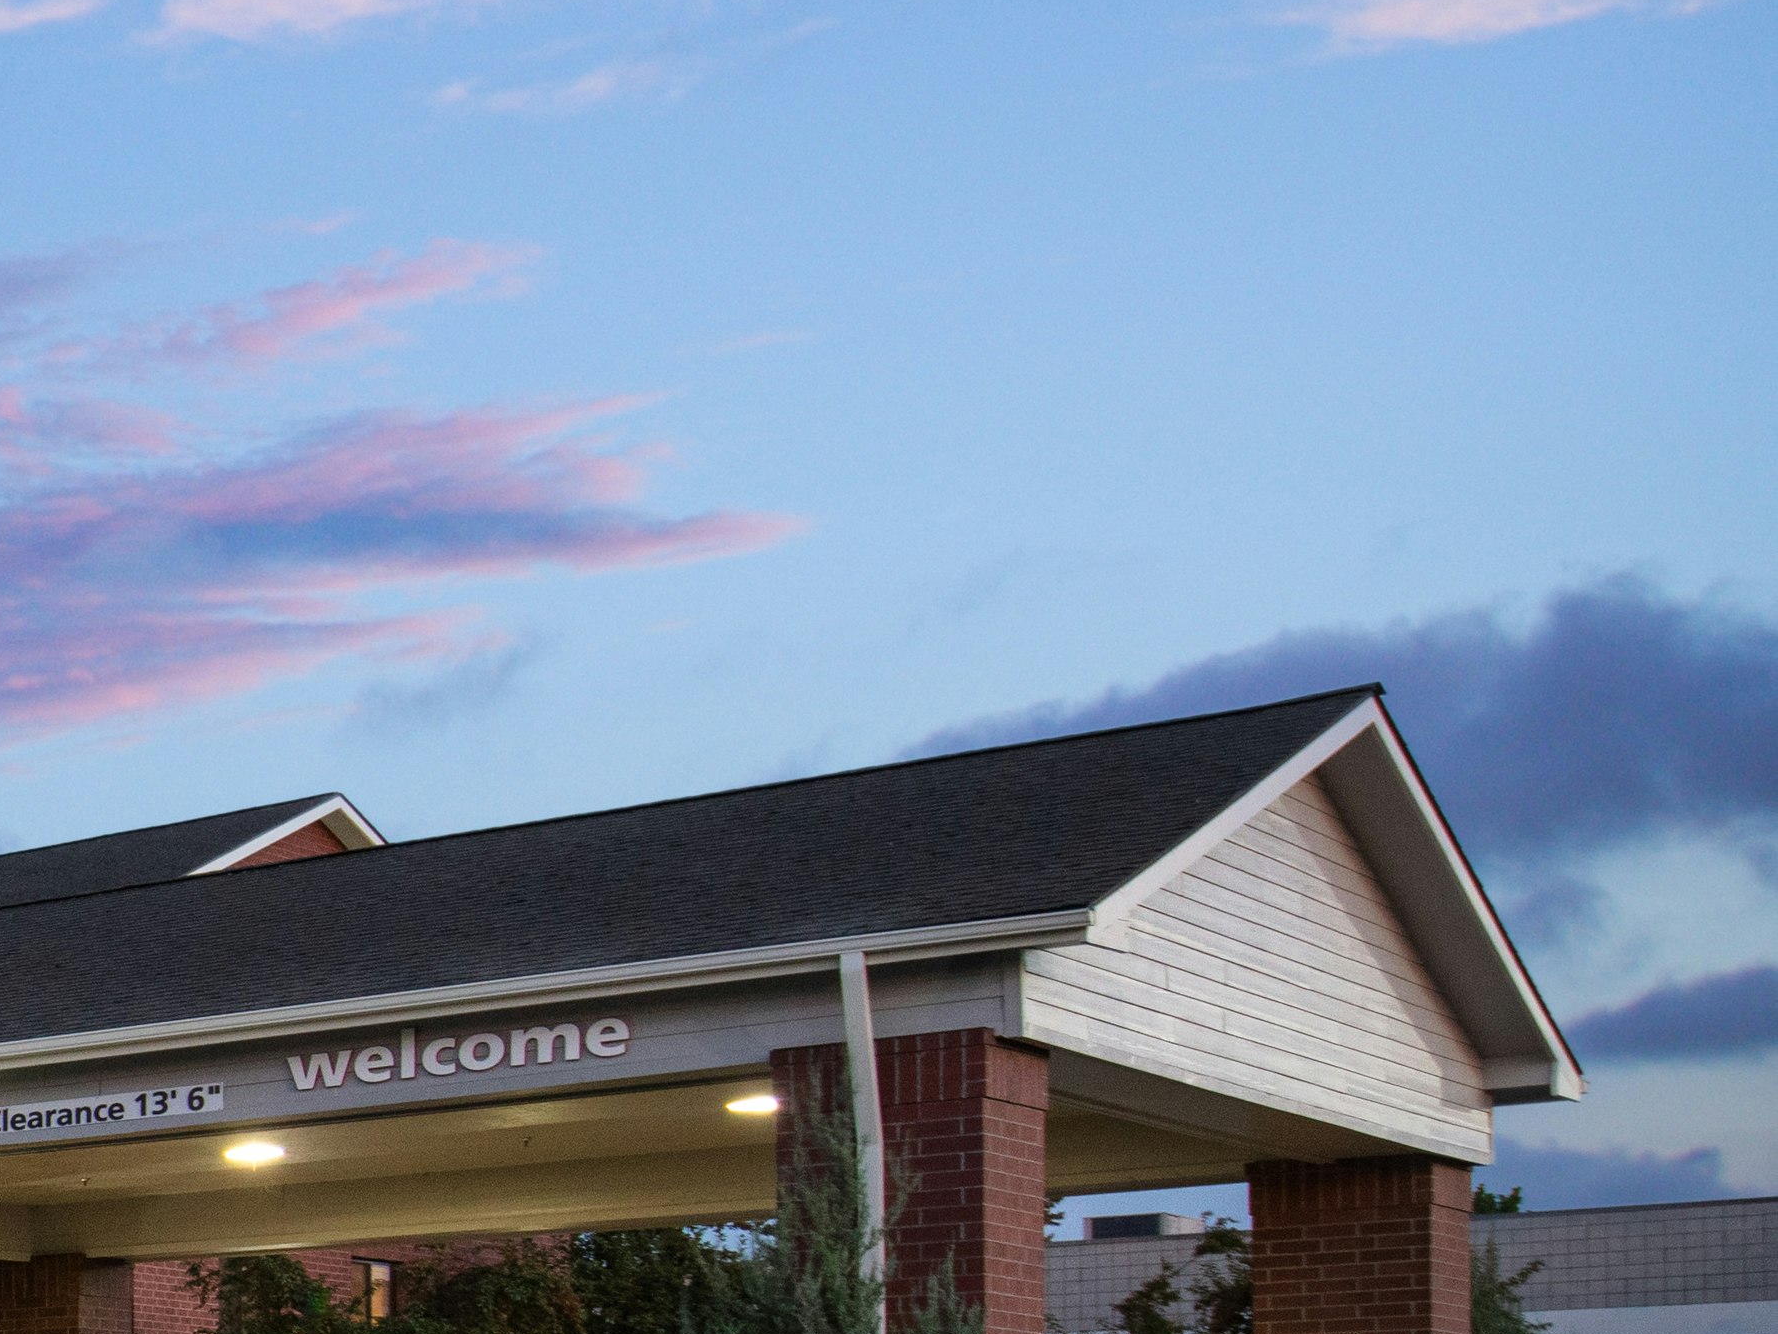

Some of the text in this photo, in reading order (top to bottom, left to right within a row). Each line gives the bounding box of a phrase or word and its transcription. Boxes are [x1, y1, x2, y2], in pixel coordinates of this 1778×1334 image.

[286, 1017, 631, 1091] welcome
[134, 1089, 177, 1117] 13'
[186, 1085, 221, 1112] 6"
